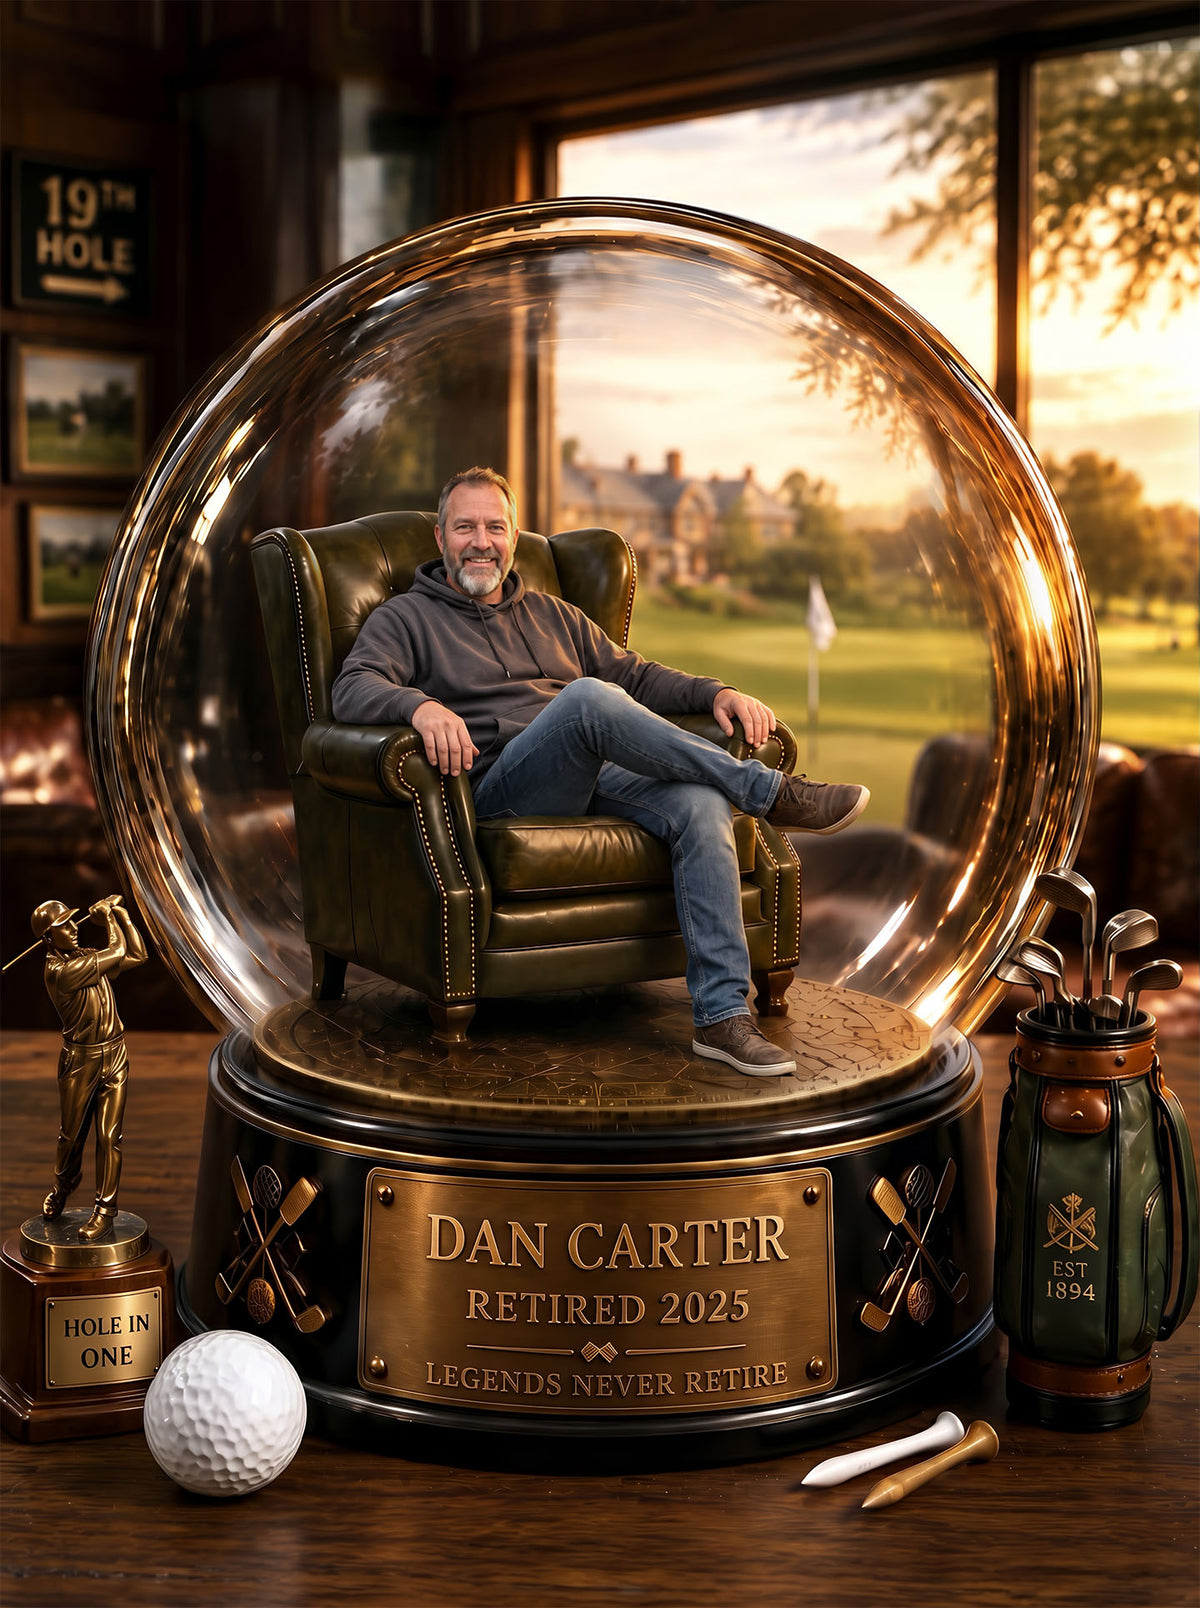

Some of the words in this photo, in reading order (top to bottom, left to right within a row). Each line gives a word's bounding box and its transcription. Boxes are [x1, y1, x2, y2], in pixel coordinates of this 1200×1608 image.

[41, 174, 136, 228] 19TH
[36, 228, 135, 274] HOLE
[426, 1213, 547, 1269] DAN
[567, 1214, 789, 1270] CARTER
[1053, 1260, 1088, 1278] EST
[466, 1289, 646, 1326] RETIRED
[660, 1288, 750, 1325] 2025
[1046, 1280, 1096, 1301] 1894
[64, 1316, 122, 1337] HOLE
[128, 1313, 150, 1333] IN
[80, 1345, 133, 1369] ONE
[425, 1361, 562, 1397] LEGENDS
[571, 1373, 674, 1397] NEVER
[684, 1361, 789, 1395] RETIRE
